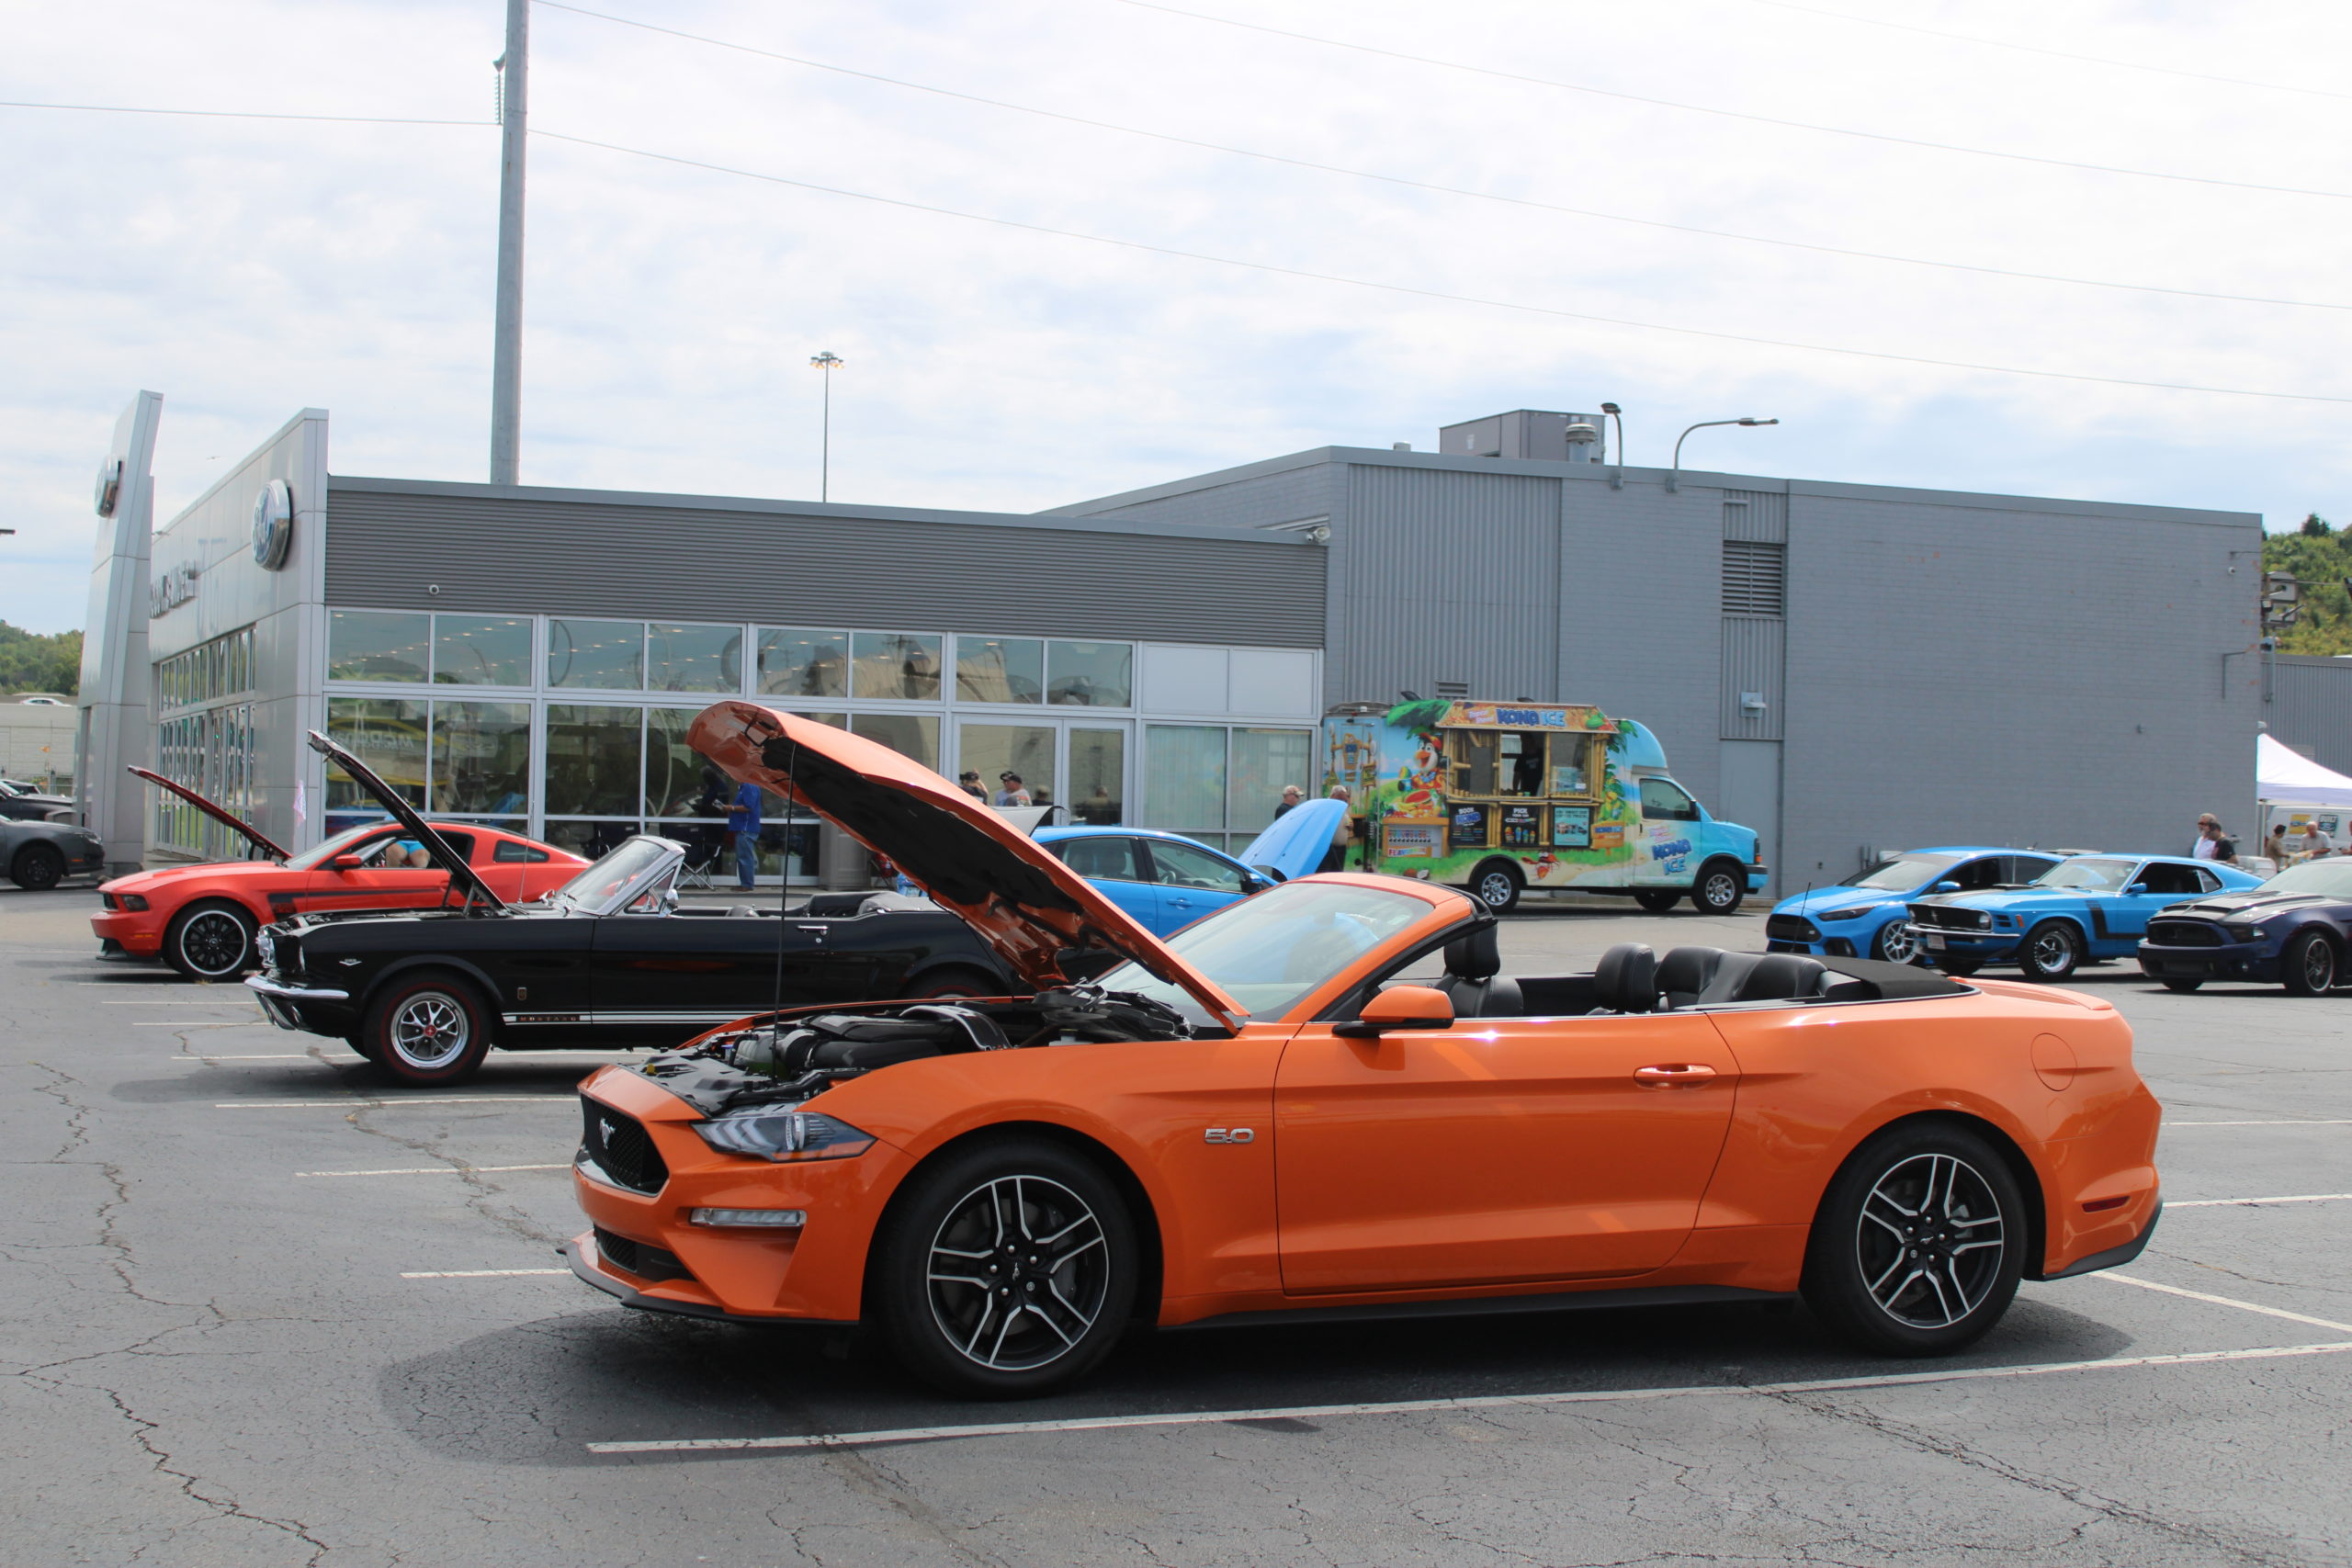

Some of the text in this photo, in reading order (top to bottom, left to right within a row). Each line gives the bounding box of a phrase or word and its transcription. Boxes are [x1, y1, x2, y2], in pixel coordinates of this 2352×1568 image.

[1496, 708, 1539, 726] KONA
[1541, 711, 1566, 728] ICE
[1652, 839, 1691, 861] KONA
[1663, 857, 1687, 875] ICE
[1204, 1128, 1254, 1144] 5.0
